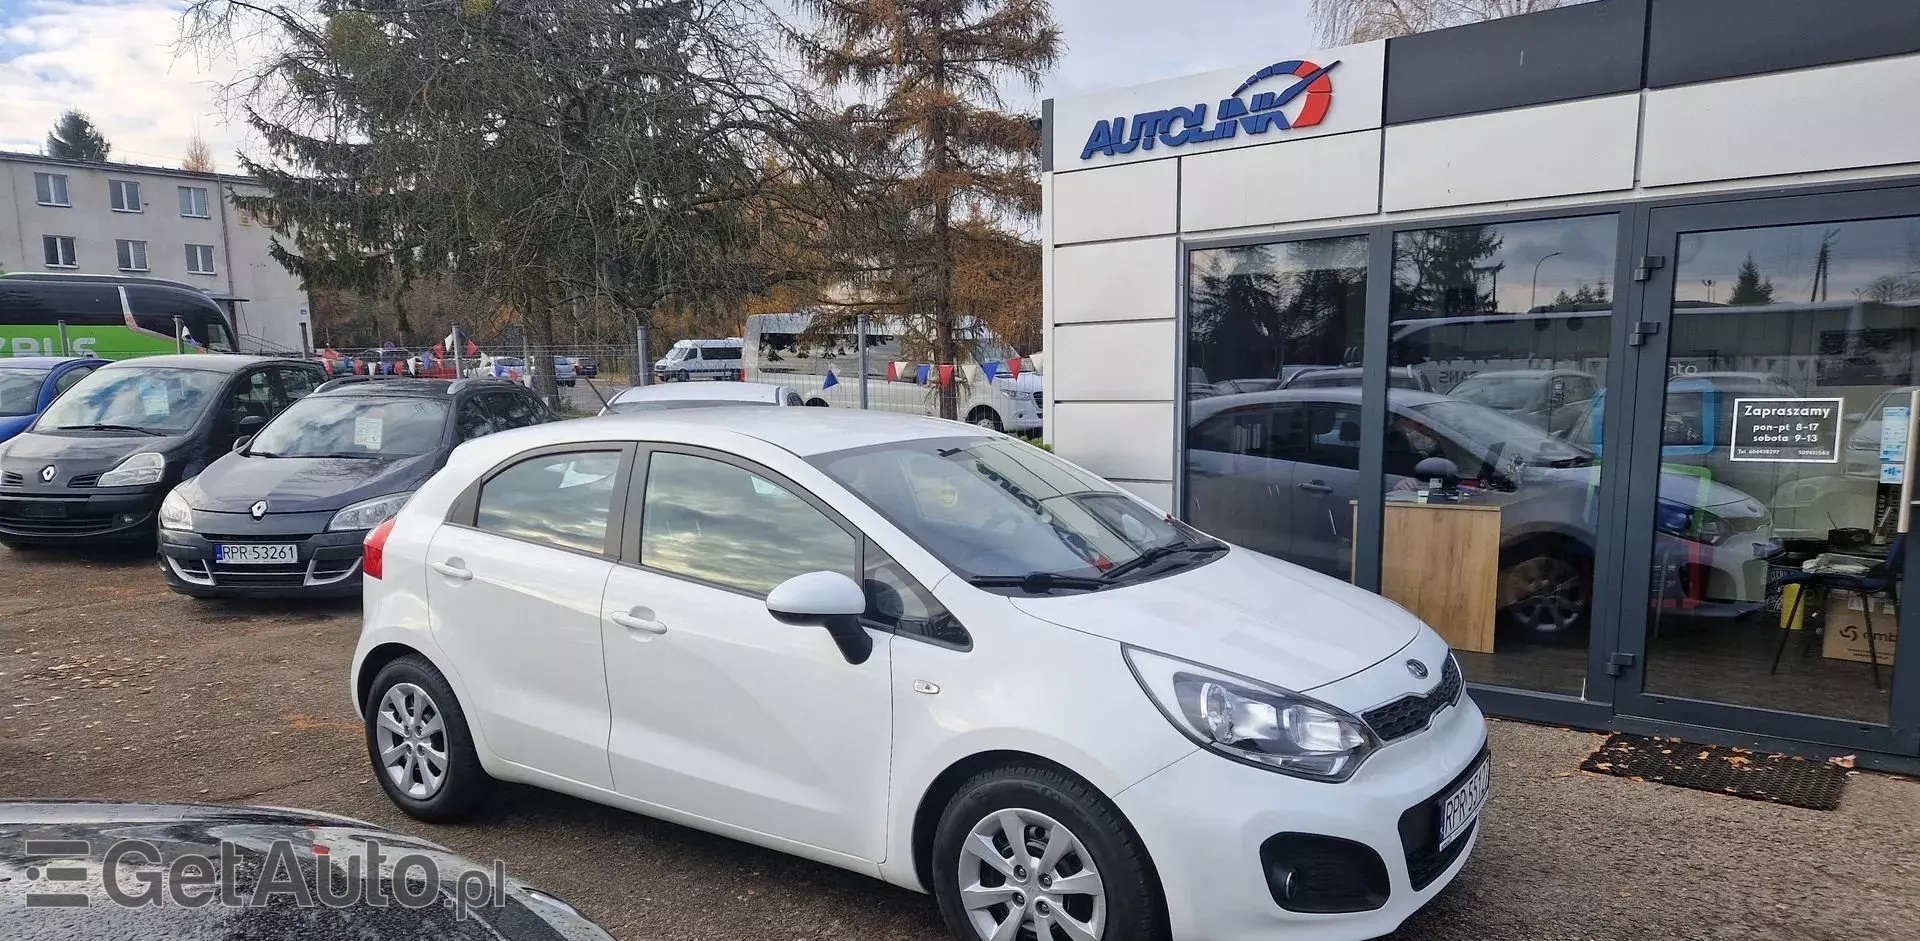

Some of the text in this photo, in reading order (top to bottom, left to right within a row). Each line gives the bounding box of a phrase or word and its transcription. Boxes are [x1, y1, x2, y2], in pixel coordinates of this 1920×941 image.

[1080, 92, 1294, 160] AUTOLINK
[1744, 405, 1830, 418] Zapraszamy
[1753, 423, 1819, 433] pon-pt 8-17
[1753, 434, 1818, 442] sobota 9-13
[223, 546, 247, 560] RPR
[252, 546, 294, 560] 53261
[1446, 788, 1465, 835] RPR
